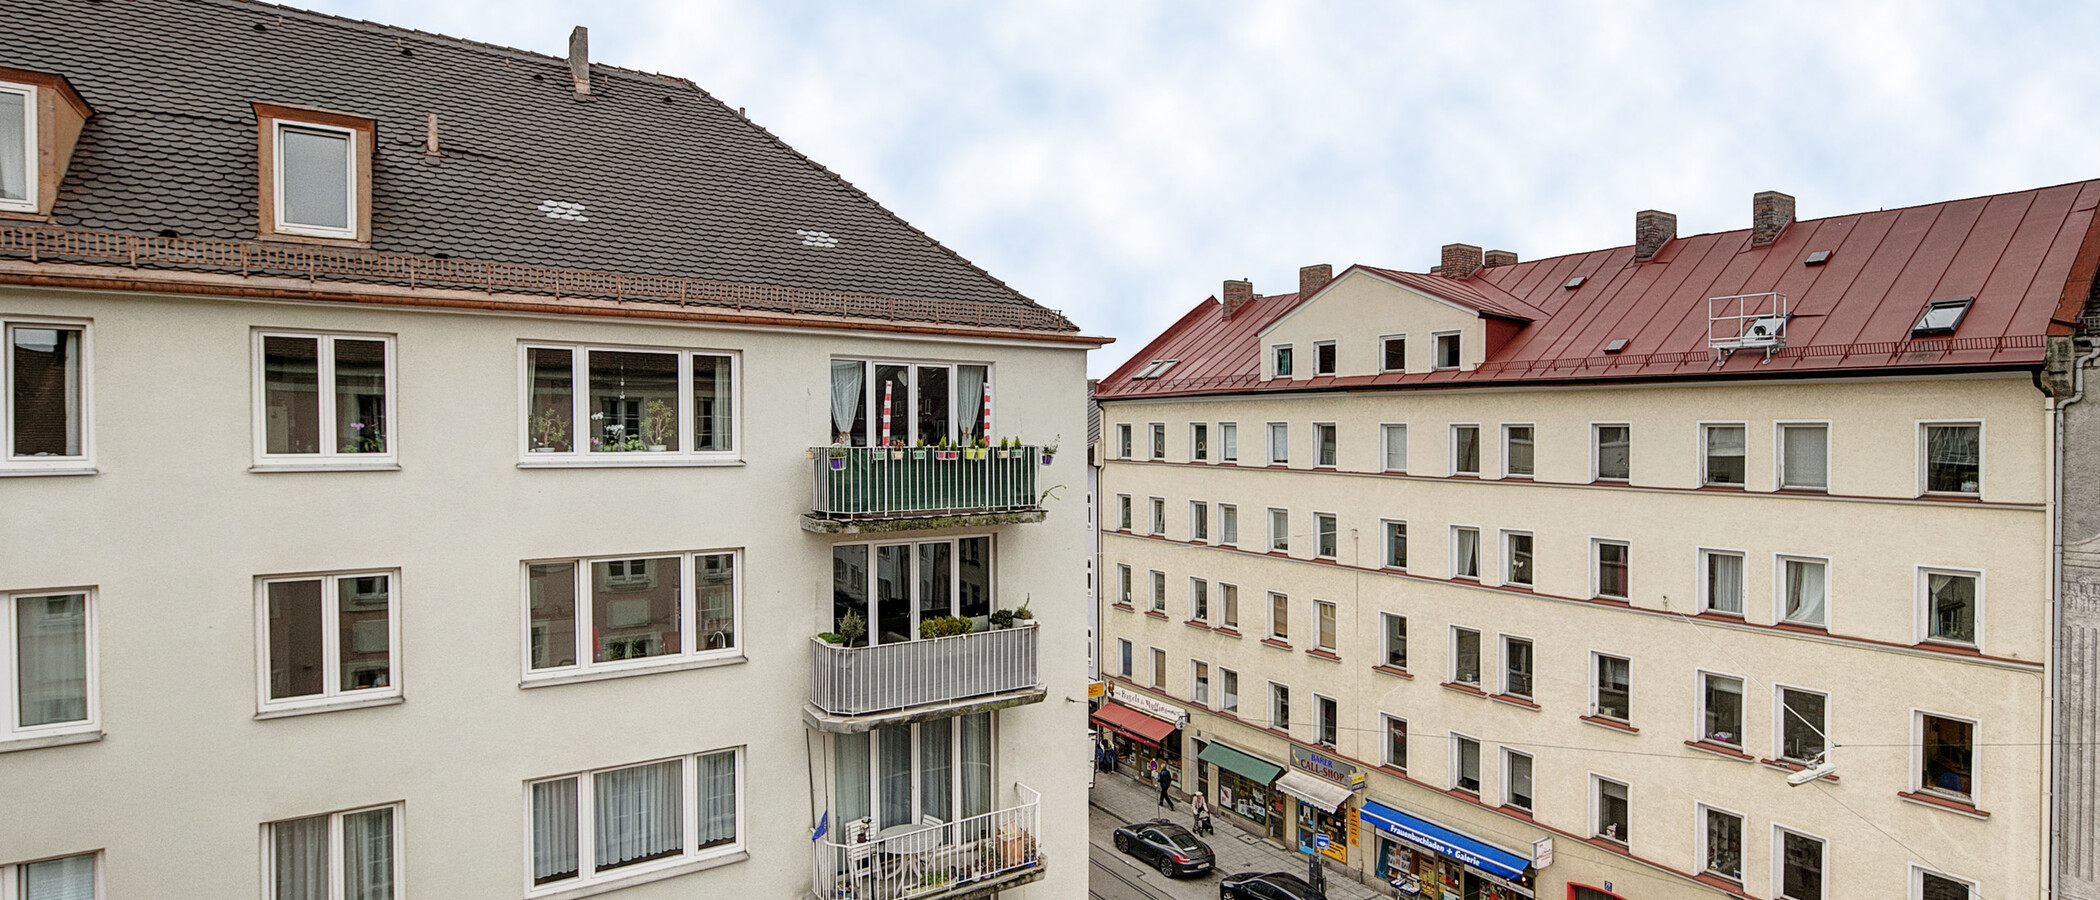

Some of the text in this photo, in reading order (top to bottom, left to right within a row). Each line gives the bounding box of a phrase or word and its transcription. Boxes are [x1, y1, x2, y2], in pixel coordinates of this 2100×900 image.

[1300, 758, 1345, 782] CALL-SHOP
[1390, 824, 1445, 853] Frauenbuchladen
[1454, 850, 1481, 867] Galerie
